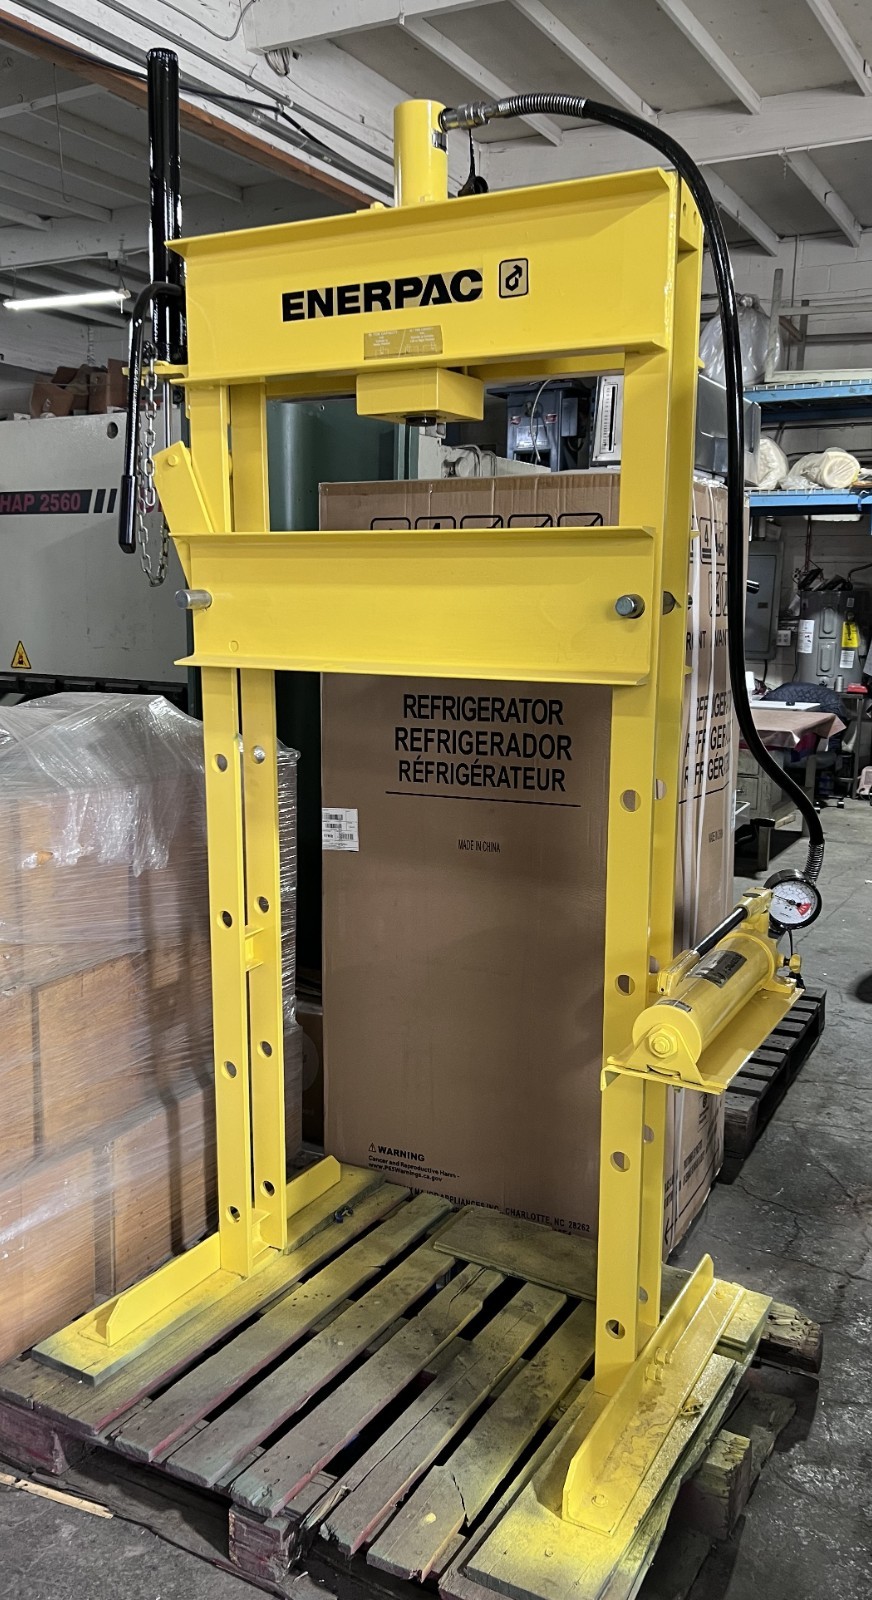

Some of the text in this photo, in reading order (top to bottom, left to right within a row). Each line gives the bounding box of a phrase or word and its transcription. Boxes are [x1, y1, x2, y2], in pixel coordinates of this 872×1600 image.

[282, 268, 483, 322] ENERPAC
[0, 492, 81, 512] HAP 2560
[403, 694, 564, 726] REFRIGERATOR
[394, 727, 572, 761] REFRIGERADOR
[398, 755, 566, 792] RÉFRIGÉRATEUR
[458, 839, 500, 852] MADE IN CHINA
[378, 1145, 425, 1161] WARNING
[368, 1155, 388, 1164] Cancer
[400, 1161, 439, 1174] Reproductive
[554, 1217, 565, 1227] NC
[568, 1220, 591, 1232] 28262
